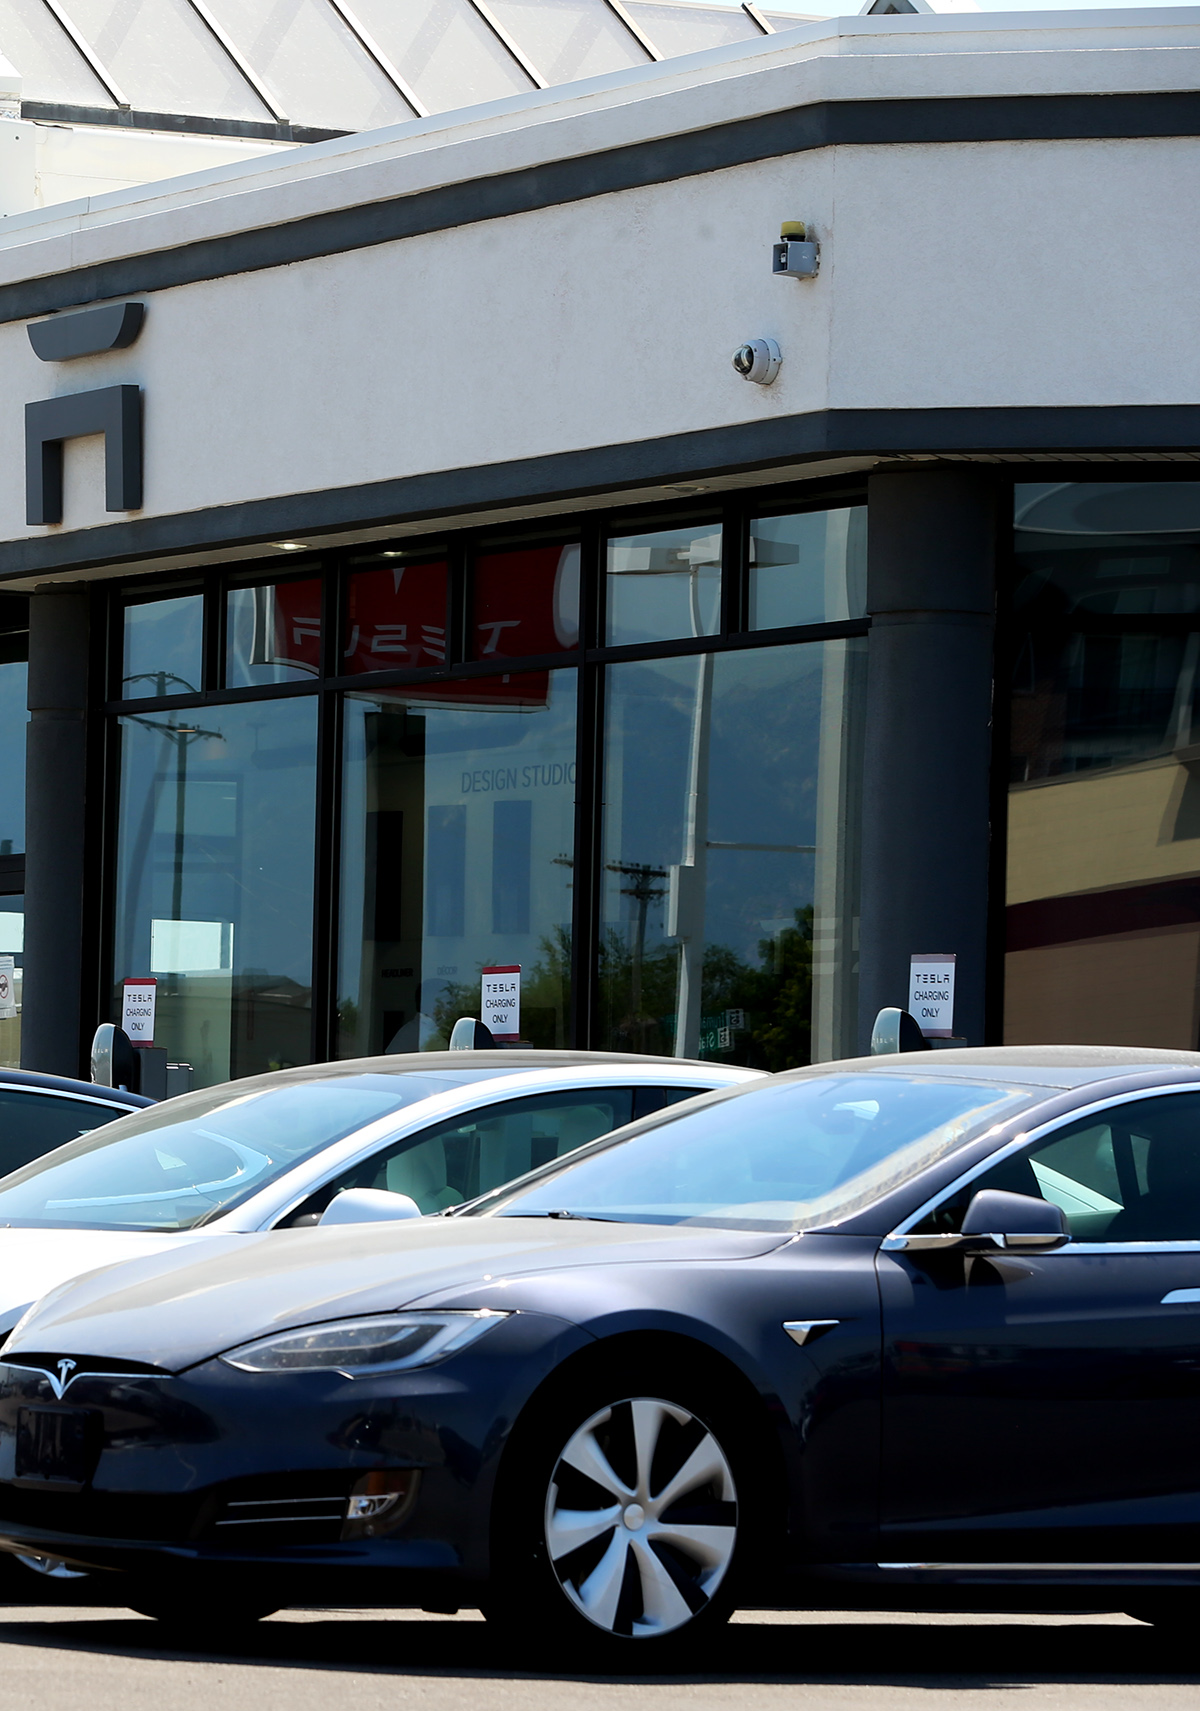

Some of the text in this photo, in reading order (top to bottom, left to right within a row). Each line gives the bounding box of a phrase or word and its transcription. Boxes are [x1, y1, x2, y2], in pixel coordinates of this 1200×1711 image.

[461, 768, 517, 794] DESIGN
[915, 974, 950, 984] TESLA
[486, 983, 516, 993] TESLA
[127, 994, 153, 1003] TESLA
[914, 990, 949, 1001] CHARGING
[485, 998, 516, 1009] CHARGING
[125, 1008, 152, 1017] CHARGING
[921, 1007, 940, 1018] ONLY
[492, 1013, 509, 1024] ONLY
[131, 1022, 145, 1031] ONLY
